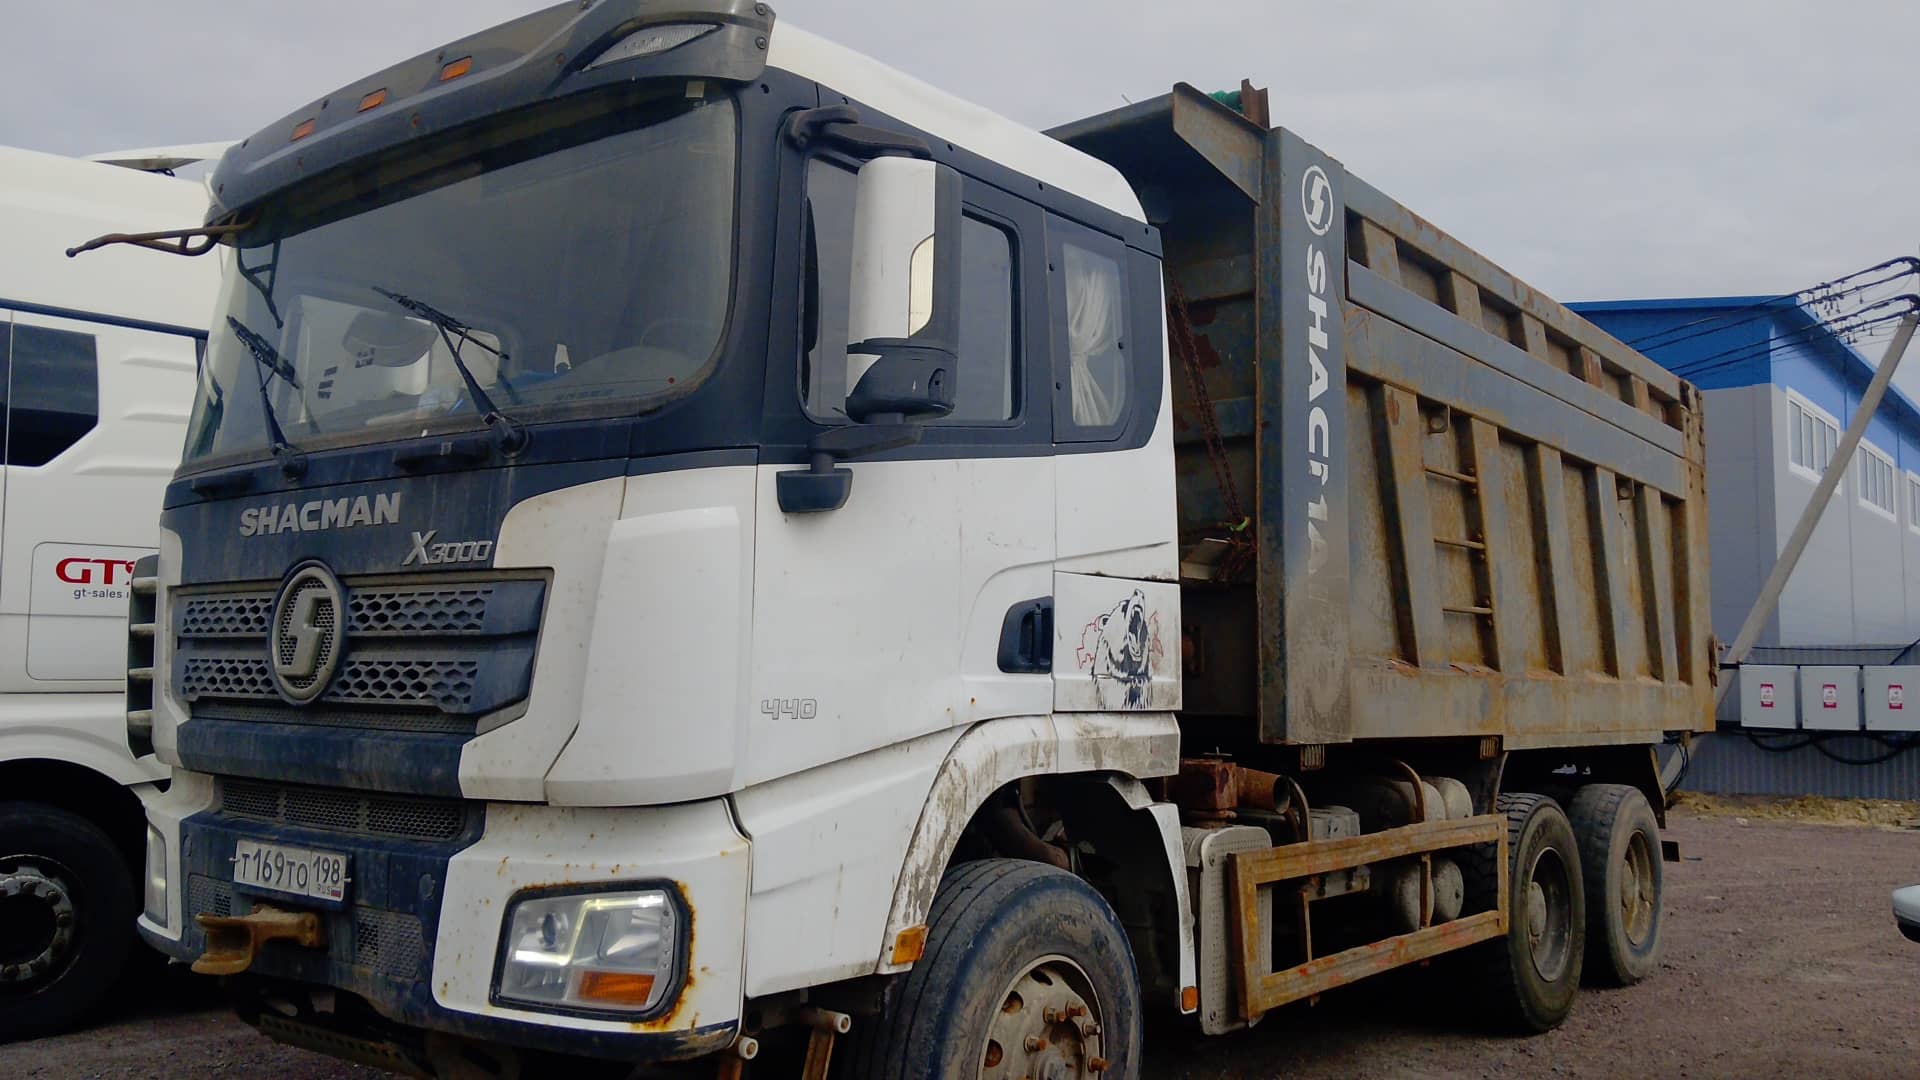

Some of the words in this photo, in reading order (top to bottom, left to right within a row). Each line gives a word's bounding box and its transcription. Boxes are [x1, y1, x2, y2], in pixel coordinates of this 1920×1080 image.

[239, 492, 401, 537] SHACMAN
[401, 529, 493, 566] X3000
[760, 698, 817, 720] 440
[312, 855, 341, 885] 198
